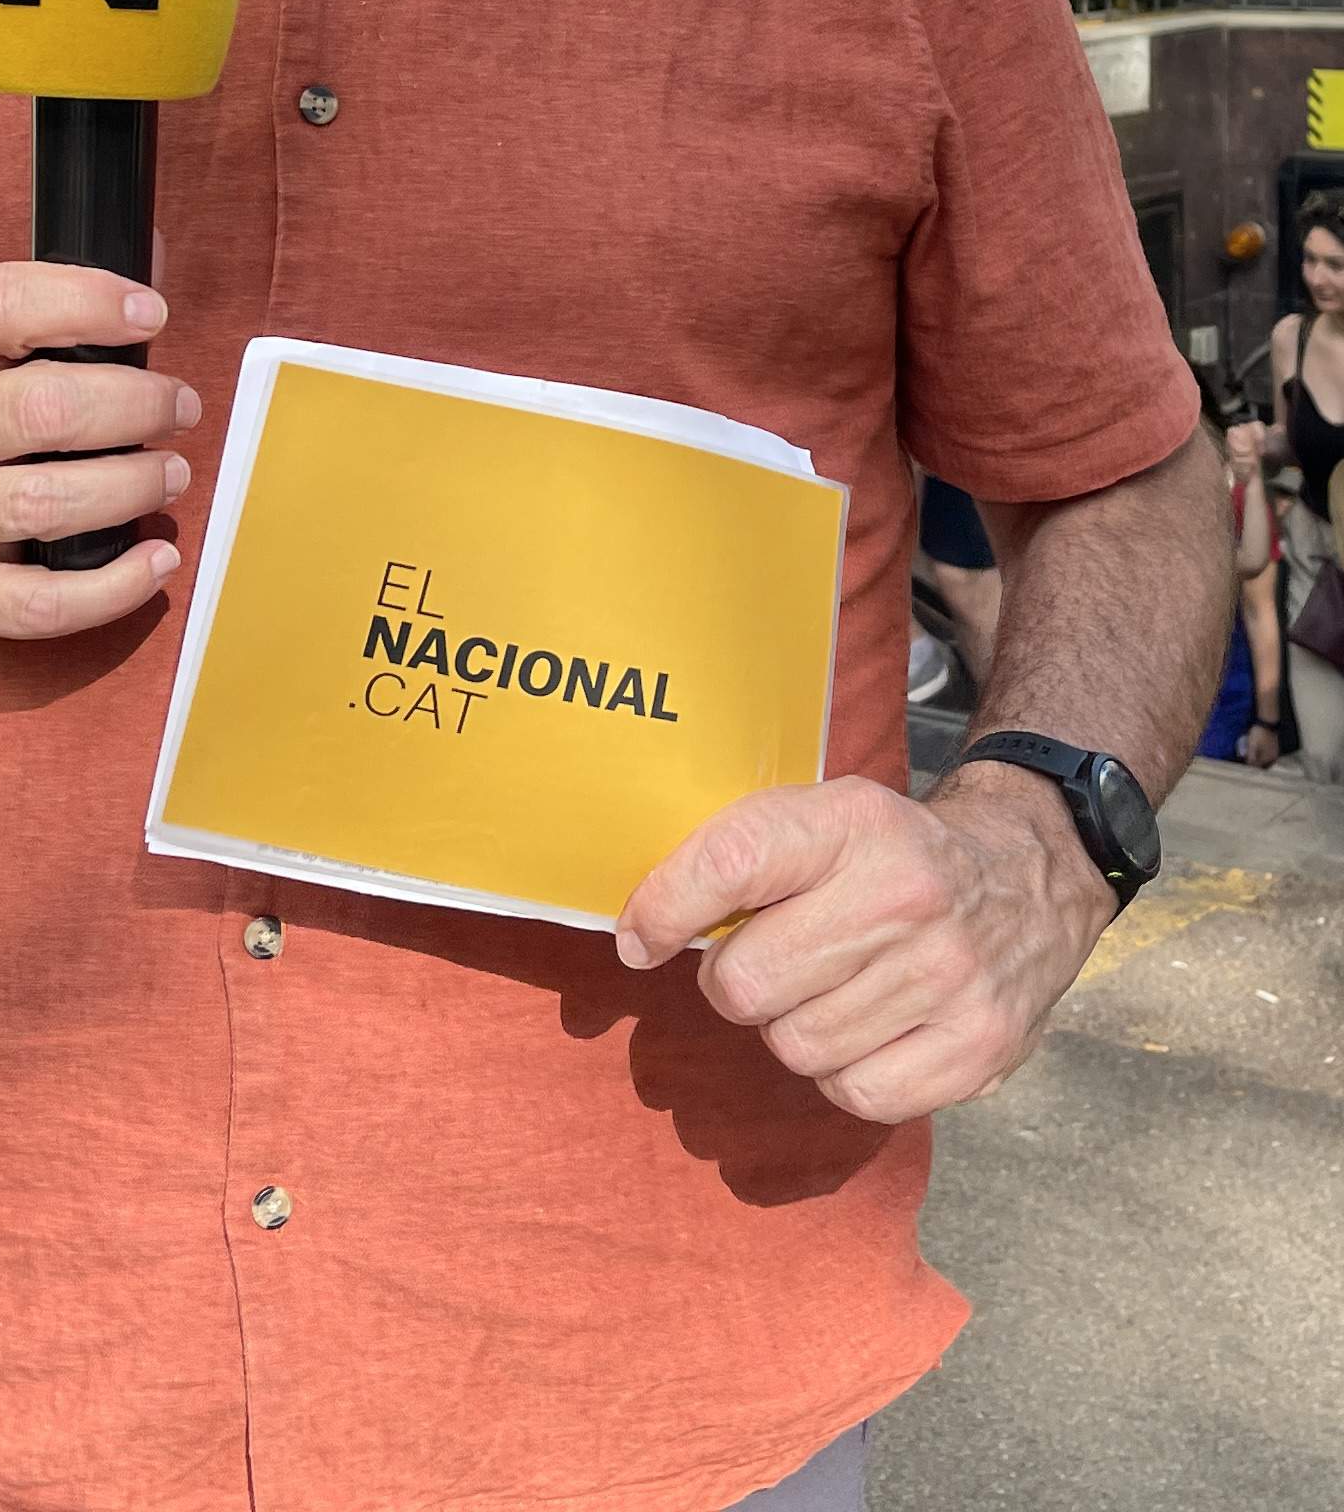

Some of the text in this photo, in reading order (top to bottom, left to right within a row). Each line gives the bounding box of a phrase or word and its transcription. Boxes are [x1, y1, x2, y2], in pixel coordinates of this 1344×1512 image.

[377, 561, 444, 620] EL
[362, 614, 678, 722] NACIONAL
[349, 672, 488, 734] .CAT
